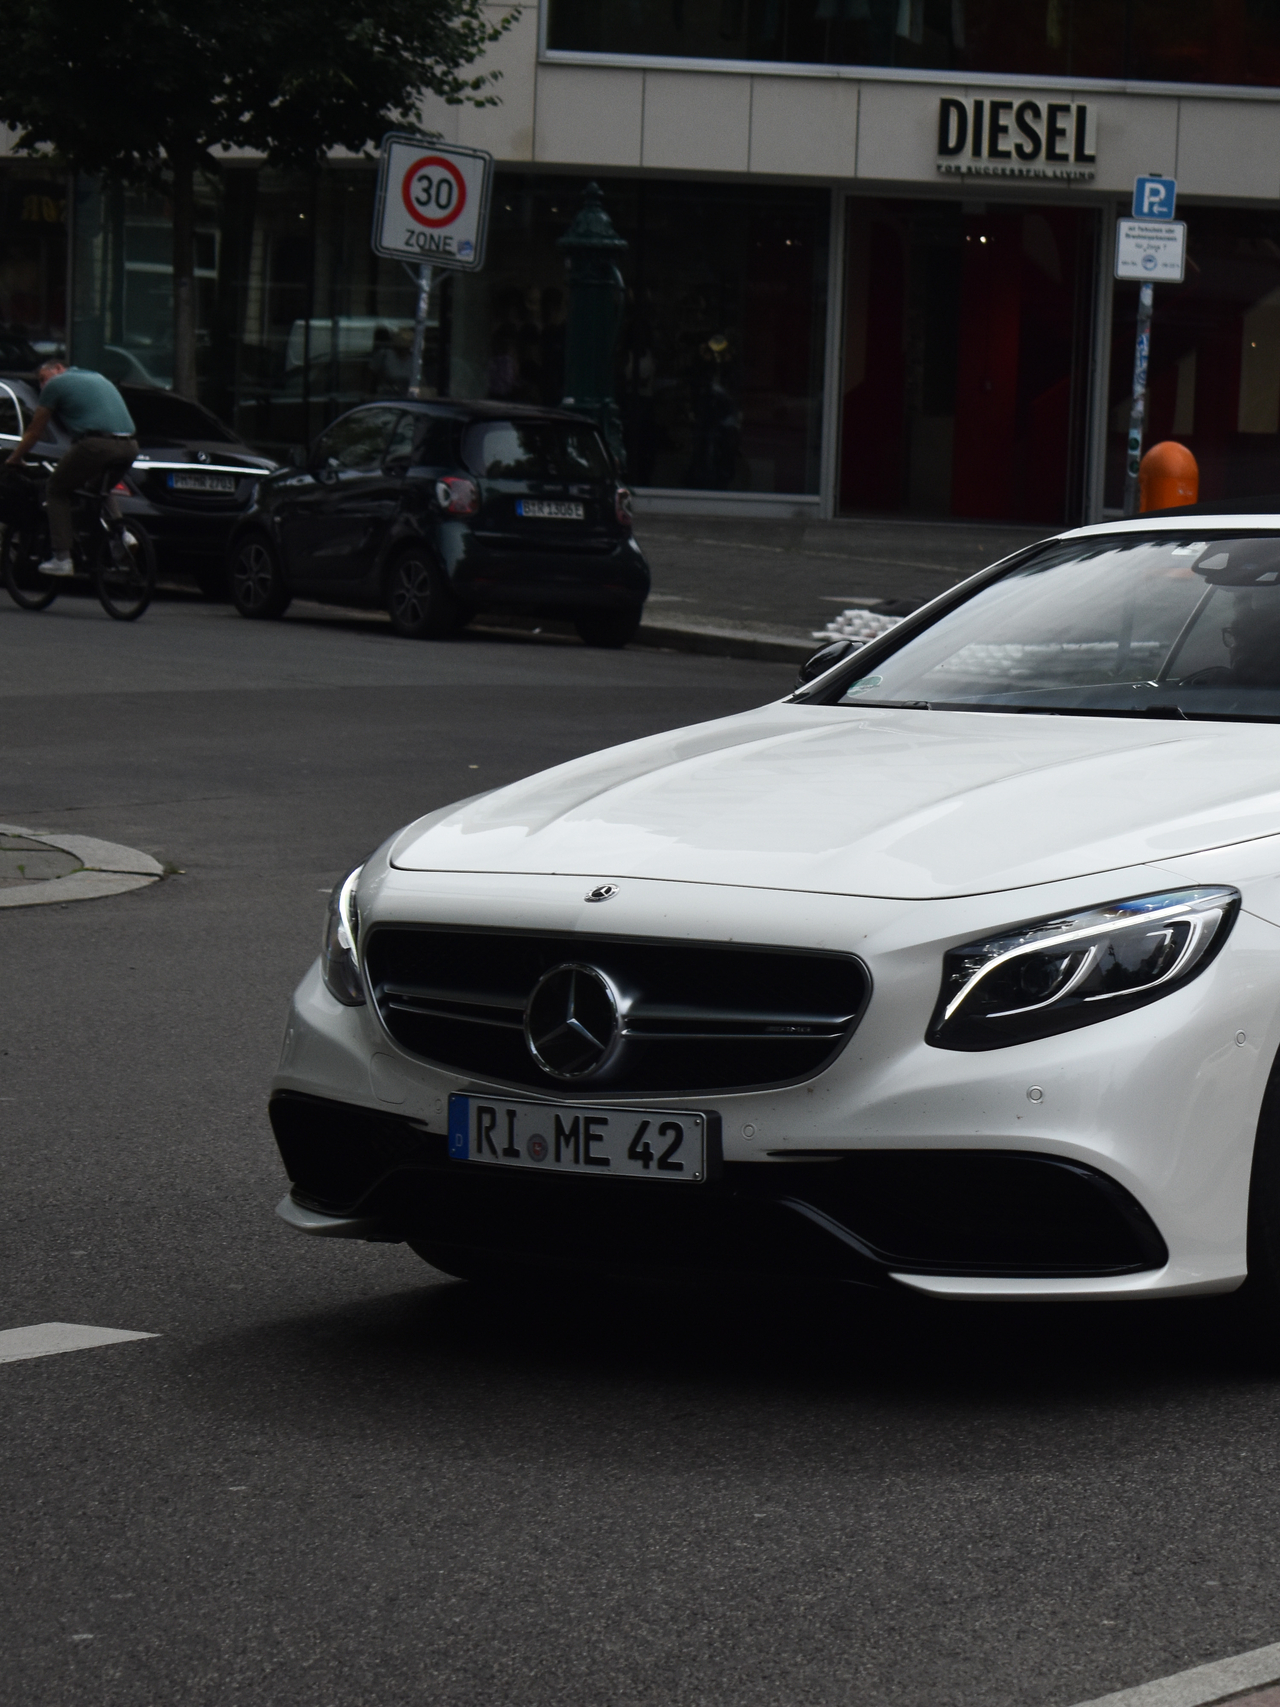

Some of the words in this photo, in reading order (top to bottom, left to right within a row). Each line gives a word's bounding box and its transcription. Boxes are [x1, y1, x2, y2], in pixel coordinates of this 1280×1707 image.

[938, 98, 1096, 163] DIESEL
[936, 163, 961, 175] FOR
[966, 165, 1048, 179] SUCCESSFUL
[1052, 169, 1095, 181] LIVING
[415, 174, 453, 210] 30
[1142, 181, 1166, 213] P
[404, 228, 454, 252] ZONE
[455, 1133, 463, 1147] D
[476, 1105, 521, 1159] RI
[554, 1114, 611, 1167] ME
[628, 1120, 684, 1172] 42
